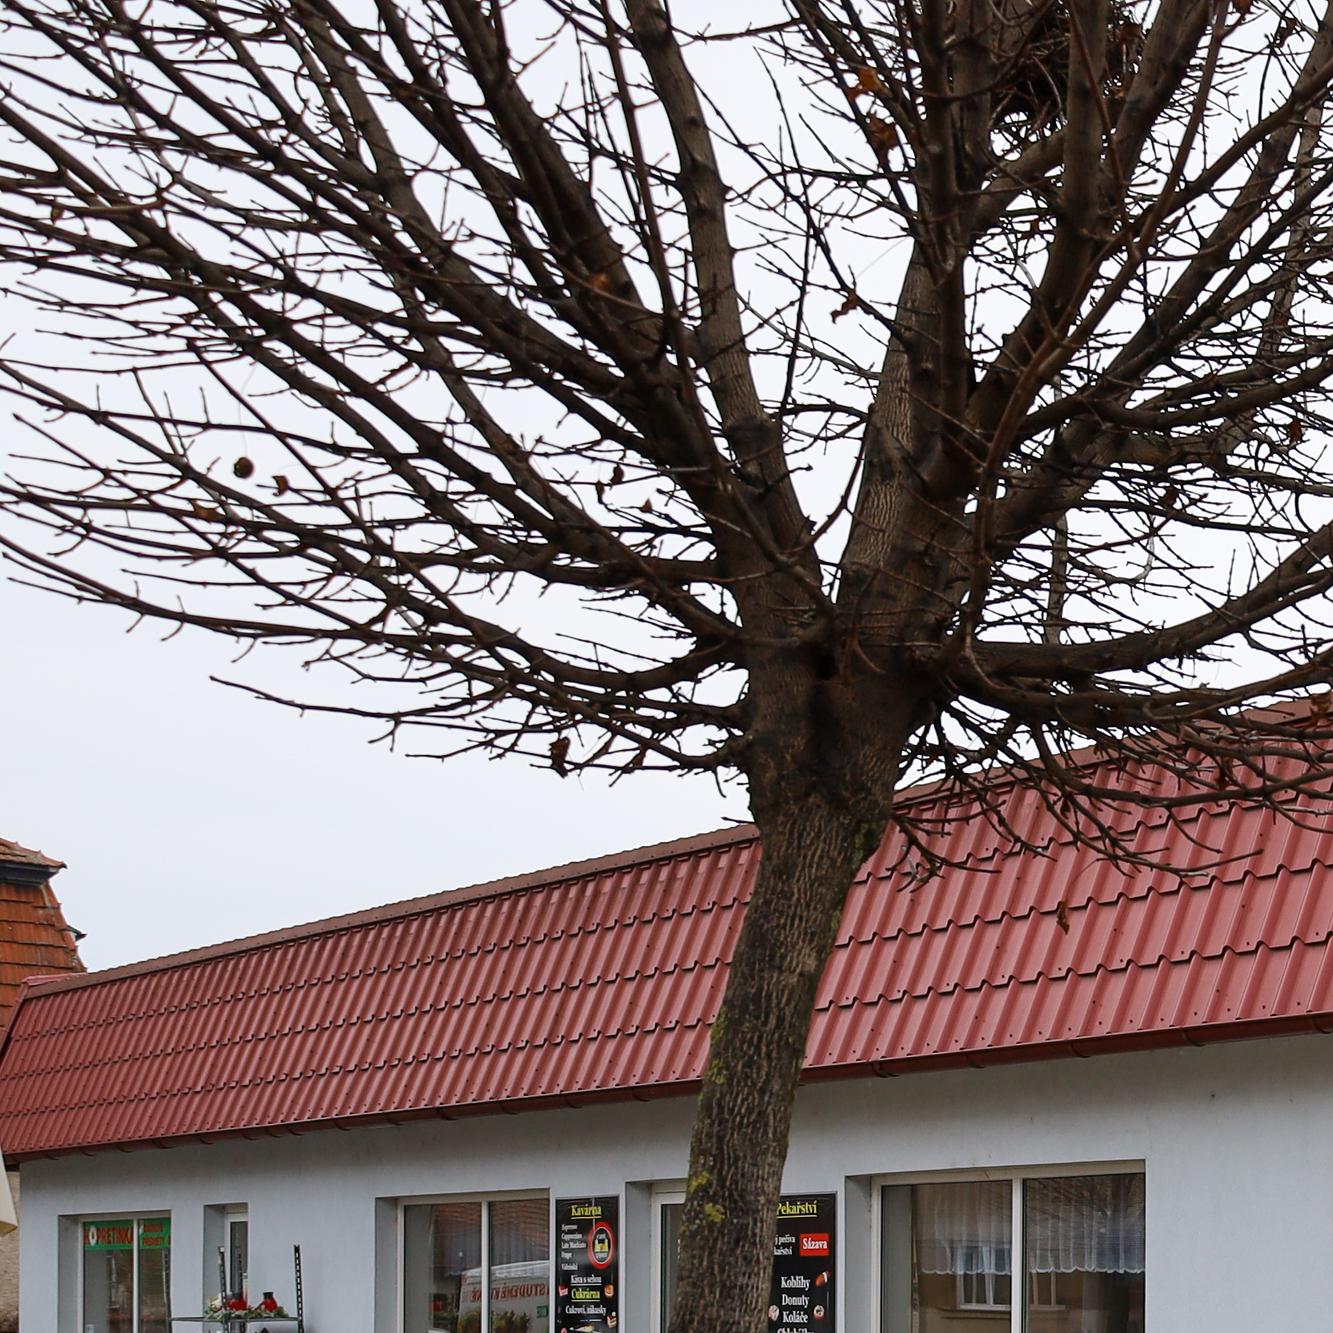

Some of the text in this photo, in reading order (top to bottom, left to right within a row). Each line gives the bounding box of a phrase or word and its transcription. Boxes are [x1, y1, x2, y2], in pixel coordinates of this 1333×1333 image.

[571, 1204, 602, 1216] Kavárna
[803, 1238, 828, 1250] Sázava
[781, 1275, 811, 1290] Koblihy
[782, 1294, 810, 1307] Donuty
[782, 1311, 809, 1323] Koláče
